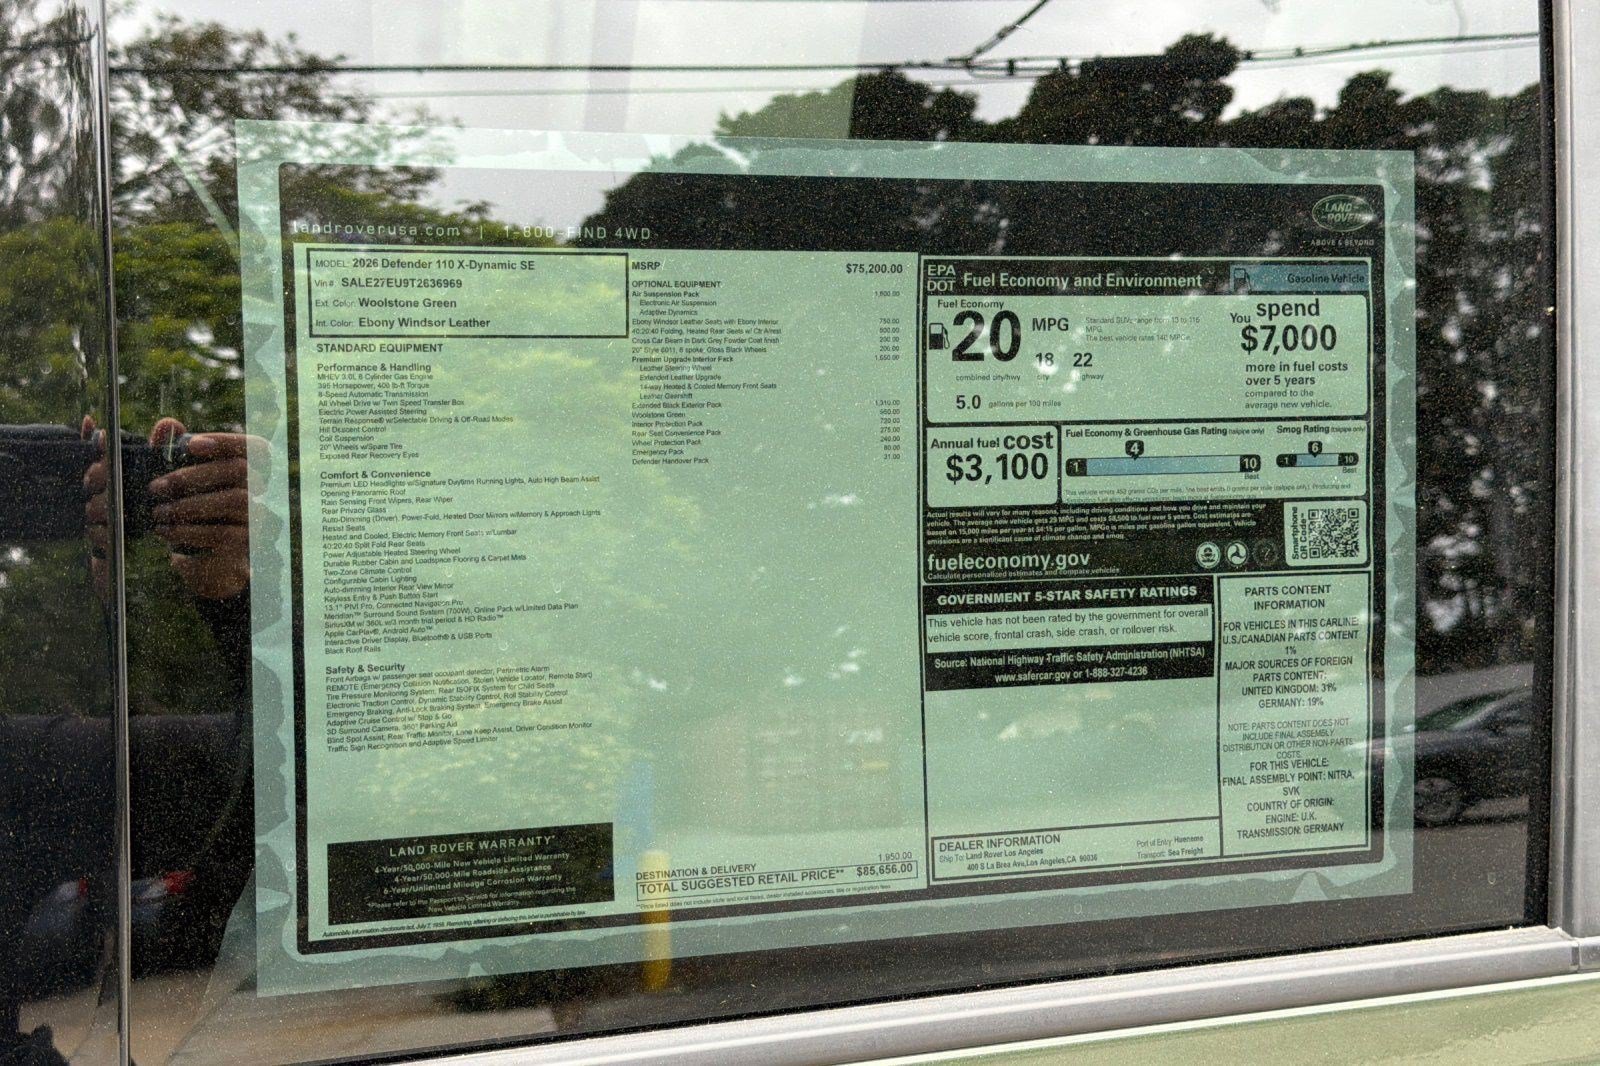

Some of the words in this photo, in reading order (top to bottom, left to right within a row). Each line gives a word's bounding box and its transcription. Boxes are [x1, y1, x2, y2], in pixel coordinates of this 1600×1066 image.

[614, 228, 651, 240] 4WD
[352, 258, 379, 269] 2026
[382, 259, 432, 270] Defender
[436, 259, 454, 270] 110
[457, 259, 517, 271] X-Dynamic
[520, 260, 535, 270] SE
[632, 262, 661, 270] MSRP
[846, 264, 903, 274] $75,200.00
[927, 265, 956, 276] EPA
[341, 278, 462, 289] SALE27EU9T2636969
[964, 273, 995, 287] Fuel
[1001, 274, 1068, 290] Economy
[1074, 273, 1102, 287] and
[1106, 274, 1203, 288] Environment
[1287, 274, 1329, 284] Gasoline
[1332, 273, 1364, 283] Vehicle
[675, 281, 721, 289] EQUIPMENT
[927, 281, 956, 291] DOT
[359, 298, 419, 308] Woolstone
[422, 298, 457, 308] Green
[938, 300, 957, 308] Fuel
[961, 300, 1004, 310] Economy
[1230, 312, 1251, 323] You
[1256, 298, 1320, 320] spend
[359, 318, 395, 330] Ebony
[398, 318, 446, 328] Windsor
[449, 318, 490, 328] Leather
[951, 310, 1022, 362] 20
[1032, 318, 1069, 332] MPG
[1240, 323, 1337, 355] $7,000
[317, 343, 376, 353] STANDARD
[379, 343, 443, 353] EQUIPMENT
[1035, 352, 1054, 366] 18
[1073, 353, 1093, 367] 22
[317, 364, 377, 372] Performance
[390, 364, 431, 373] Handling
[1246, 363, 1275, 372] more
[1280, 362, 1290, 371] in
[1293, 361, 1315, 371] fuel
[1318, 362, 1348, 371] costs
[1246, 376, 1271, 386] over
[1274, 375, 1280, 385] 5
[1285, 376, 1316, 388] years
[1245, 390, 1287, 398] compared
[1290, 389, 1298, 397] to
[1301, 389, 1313, 397] the
[956, 394, 981, 410] 5.0
[1245, 401, 1278, 410] average
[1280, 401, 1298, 409] new
[1301, 399, 1332, 408] vehicle.
[1066, 429, 1083, 437] Fuel
[1085, 429, 1122, 439] Economy
[1125, 428, 1132, 436] &
[1134, 427, 1182, 437] Greenhouse
[1184, 428, 1199, 436] Gas
[1201, 427, 1227, 437] Rating
[1276, 426, 1301, 435] Smog
[1303, 426, 1330, 435] Rating
[930, 438, 974, 449] Annual
[977, 438, 1000, 448] fuel
[1003, 432, 1055, 450] cost
[1130, 443, 1139, 454] 4
[1312, 443, 1318, 452] 6
[946, 452, 1049, 485] $3,100
[1244, 458, 1256, 469] 10
[320, 471, 359, 480] Comfort
[361, 471, 368, 479] &
[371, 470, 431, 479] Convenience
[340, 507, 366, 515] Privacy
[1291, 506, 1299, 560] Smartphone
[1300, 545, 1308, 560] QR
[927, 551, 1090, 571] fueleconomy.gov
[937, 592, 1030, 606] GOVERNMENT
[1035, 591, 1080, 602] 5-STAR
[1085, 589, 1135, 600] SAFETY
[1140, 586, 1197, 598] RATINGS
[1245, 586, 1279, 596] PARTS
[1281, 584, 1331, 595] CONTENT
[1254, 599, 1325, 610] INFORMATION
[928, 619, 948, 628] This
[950, 617, 983, 627] vehicle
[985, 616, 1003, 626] has
[1005, 615, 1020, 625] not
[1023, 614, 1046, 624] been
[1048, 613, 1073, 623] rated
[1075, 612, 1086, 623] by
[1088, 611, 1103, 621] the
[1106, 609, 1161, 622] government
[1163, 609, 1176, 619] for
[1178, 607, 1208, 618] overall
[928, 633, 961, 643] vehicle
[963, 631, 992, 642] score,
[994, 630, 1024, 640] frontal
[1026, 629, 1054, 639] crash,
[1056, 627, 1075, 637] side
[1078, 626, 1107, 637] crash,
[1109, 626, 1119, 634] or
[1122, 624, 1156, 634] rollover
[1158, 623, 1177, 633] risk.
[935, 658, 968, 669] Source:
[970, 655, 1005, 666] National
[1008, 653, 1044, 666] Highway
[1047, 652, 1074, 663] Traffic
[1076, 650, 1103, 663] Safety
[1106, 649, 1168, 660] Administration
[1170, 646, 1205, 659] (NHTSA)
[326, 665, 355, 675] Safety
[357, 664, 365, 673] &
[367, 663, 405, 673] Security
[995, 670, 1071, 684] www.safercar.gov
[1073, 670, 1082, 678] or
[1250, 762, 1267, 771] FOR
[1271, 760, 1288, 769] THIS
[1291, 757, 1329, 768] VEHICLE:
[1223, 777, 1247, 787] FINAL
[1250, 773, 1295, 785] ASSEMBLY
[1298, 772, 1326, 782] POINT:
[1328, 769, 1354, 780] NITRA,
[1283, 786, 1300, 796] SVK
[939, 839, 984, 852] DEALER
[987, 834, 1061, 849] INFORMATION
[390, 846, 425, 857] LAND
[430, 842, 473, 853] ROVER
[966, 851, 982, 859] Land
[984, 850, 1003, 858] Rover
[1005, 849, 1016, 857] Los
[1018, 848, 1044, 857] Angeles
[878, 852, 912, 862] 1,950.00
[636, 867, 699, 881] DESTINATION
[710, 863, 757, 875] DELIVERY
[640, 882, 678, 894] TOTAL
[681, 876, 755, 892] SUGGESTED
[758, 872, 798, 885] RETAIL
[857, 863, 913, 878] $85,656.00
